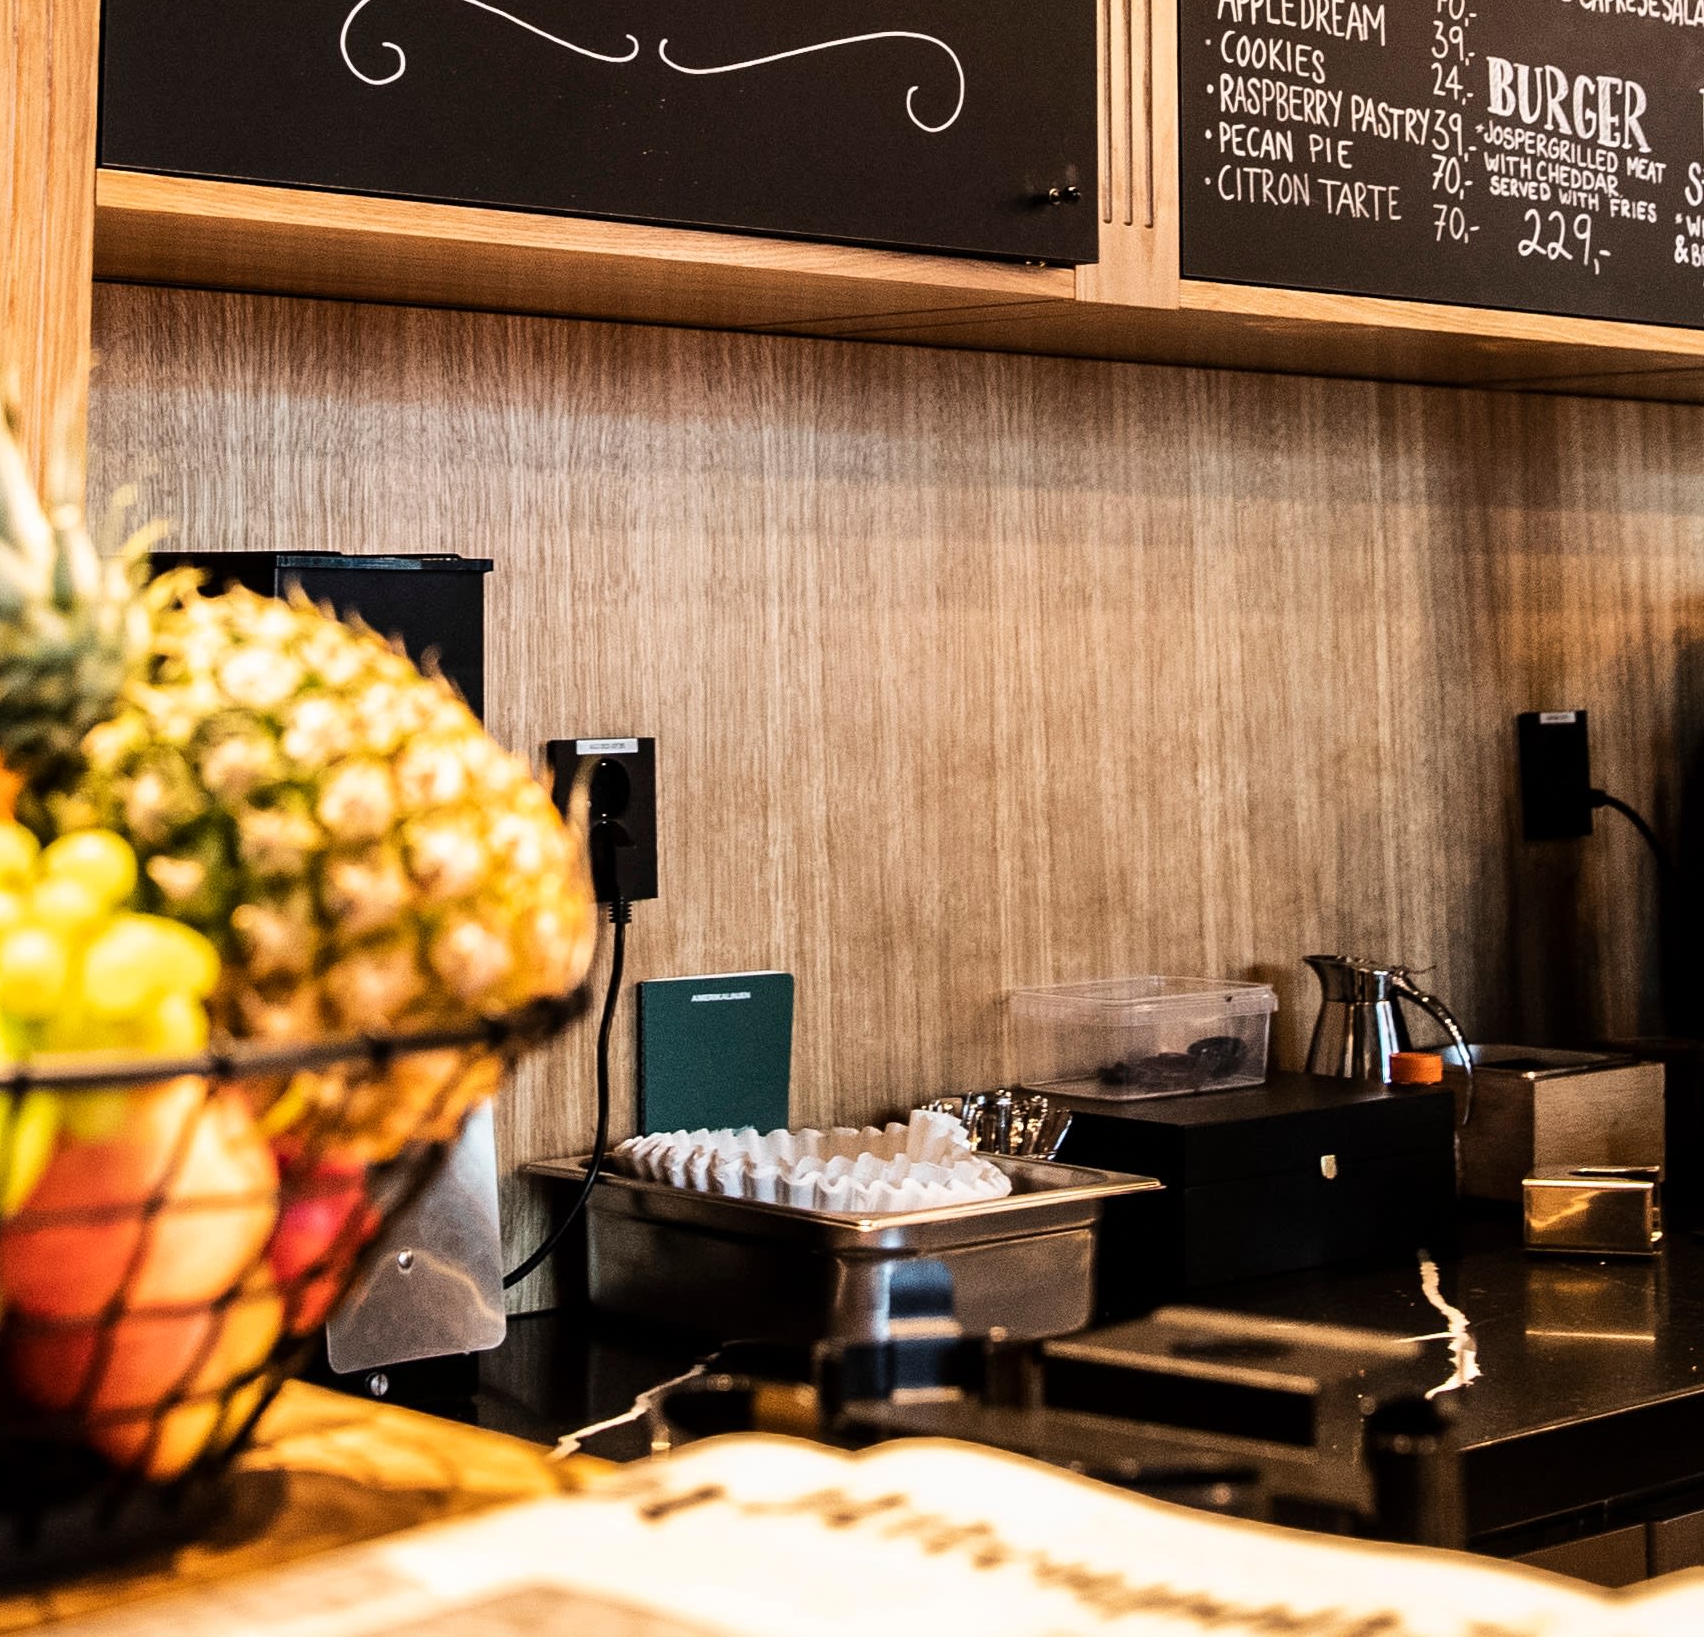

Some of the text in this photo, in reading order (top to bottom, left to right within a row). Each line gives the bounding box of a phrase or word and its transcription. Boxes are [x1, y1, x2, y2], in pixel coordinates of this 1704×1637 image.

[1221, 30, 1325, 84] COOKIES
[1220, 73, 1430, 145] RASPBERRY PASTRY
[1486, 56, 1652, 153] BURGER
[1219, 122, 1353, 169] PECAN PIE
[1484, 120, 1666, 183] JOSPERGRILLED MEAT
[1218, 165, 1401, 221] CITRON TARTE
[1484, 152, 1623, 198] WITH CHEDDAR
[1489, 175, 1657, 223] SERVED WITH FRIES
